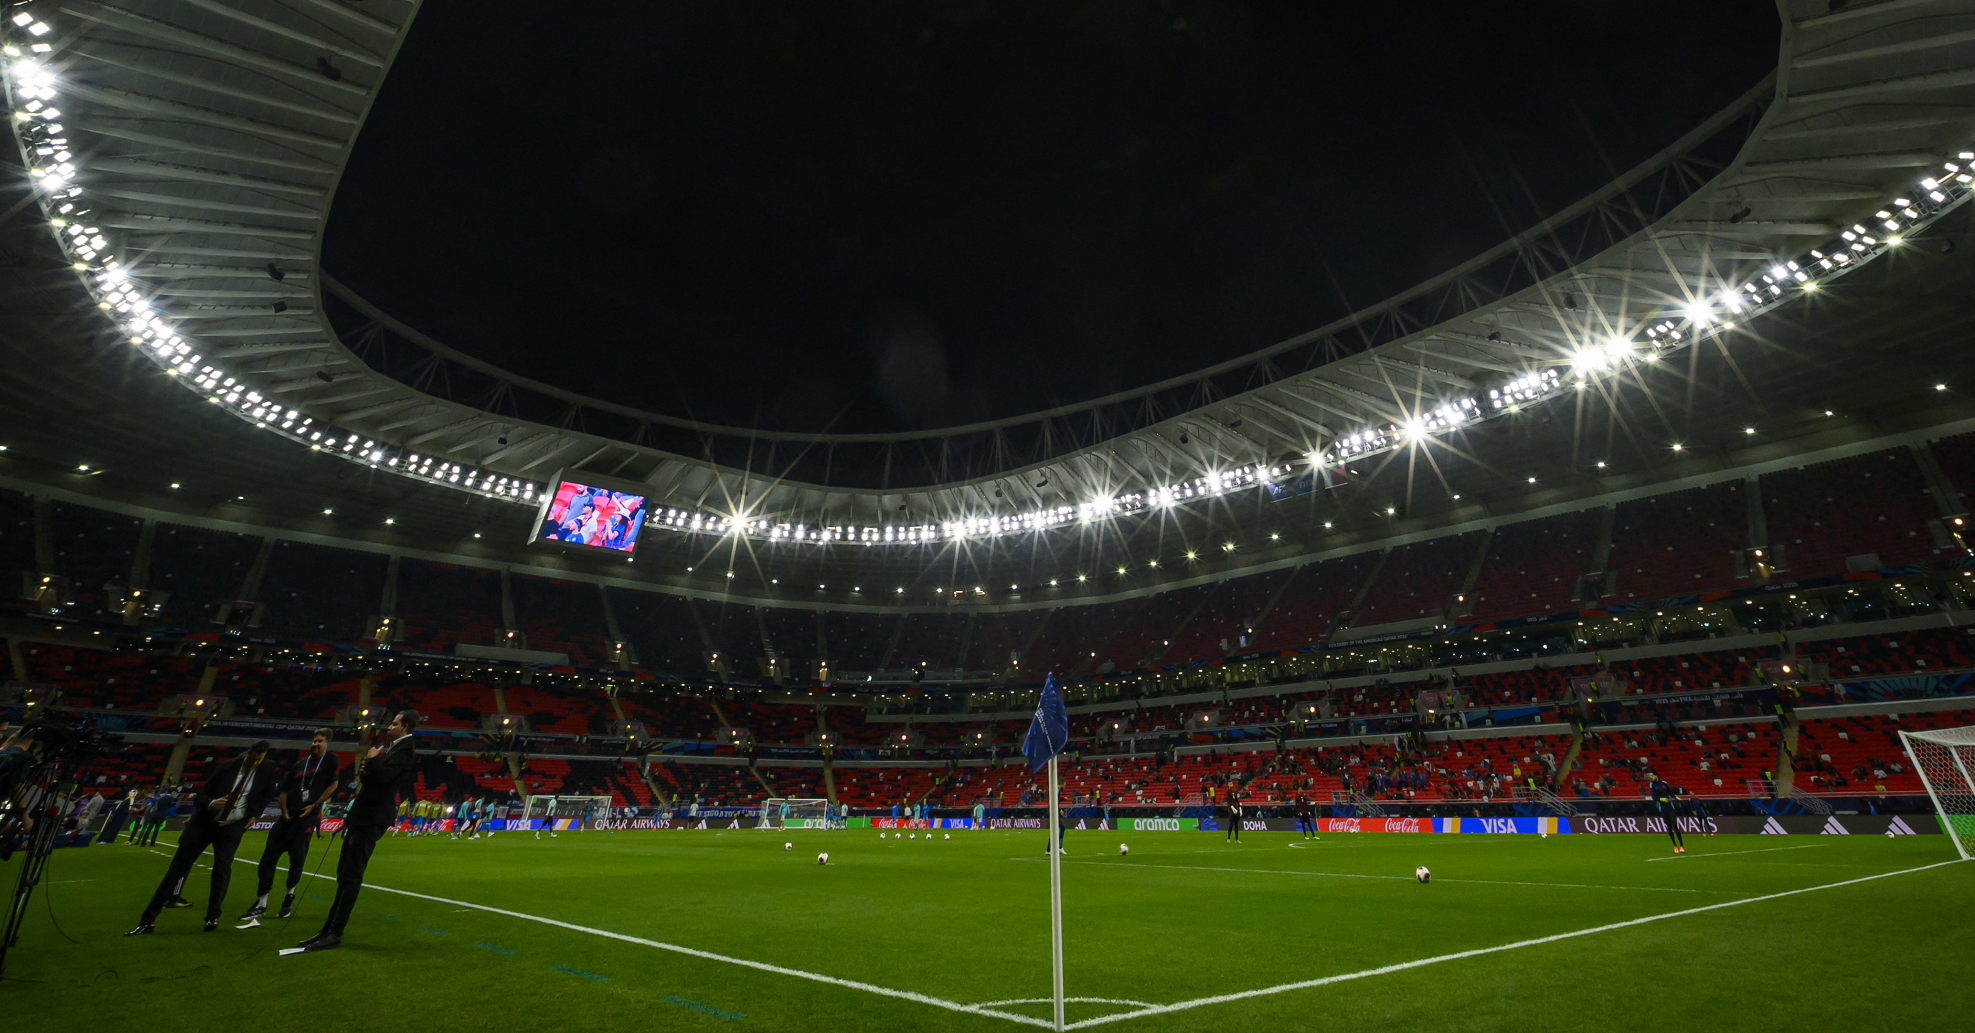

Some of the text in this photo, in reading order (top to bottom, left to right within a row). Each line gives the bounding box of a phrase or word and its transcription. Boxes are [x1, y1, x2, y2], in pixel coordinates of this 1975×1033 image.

[221, 721, 275, 729] INTERCONTINENTAL
[505, 819, 532, 831] VISA
[630, 819, 671, 829] AIRWAYS
[949, 818, 964, 829] VISA
[990, 818, 1041, 828] QATAR AIRWAYS
[1133, 818, 1180, 831] aramco
[1242, 820, 1268, 831] DOHA
[1479, 818, 1518, 834] VISA
[1584, 817, 1640, 834] QATAR
